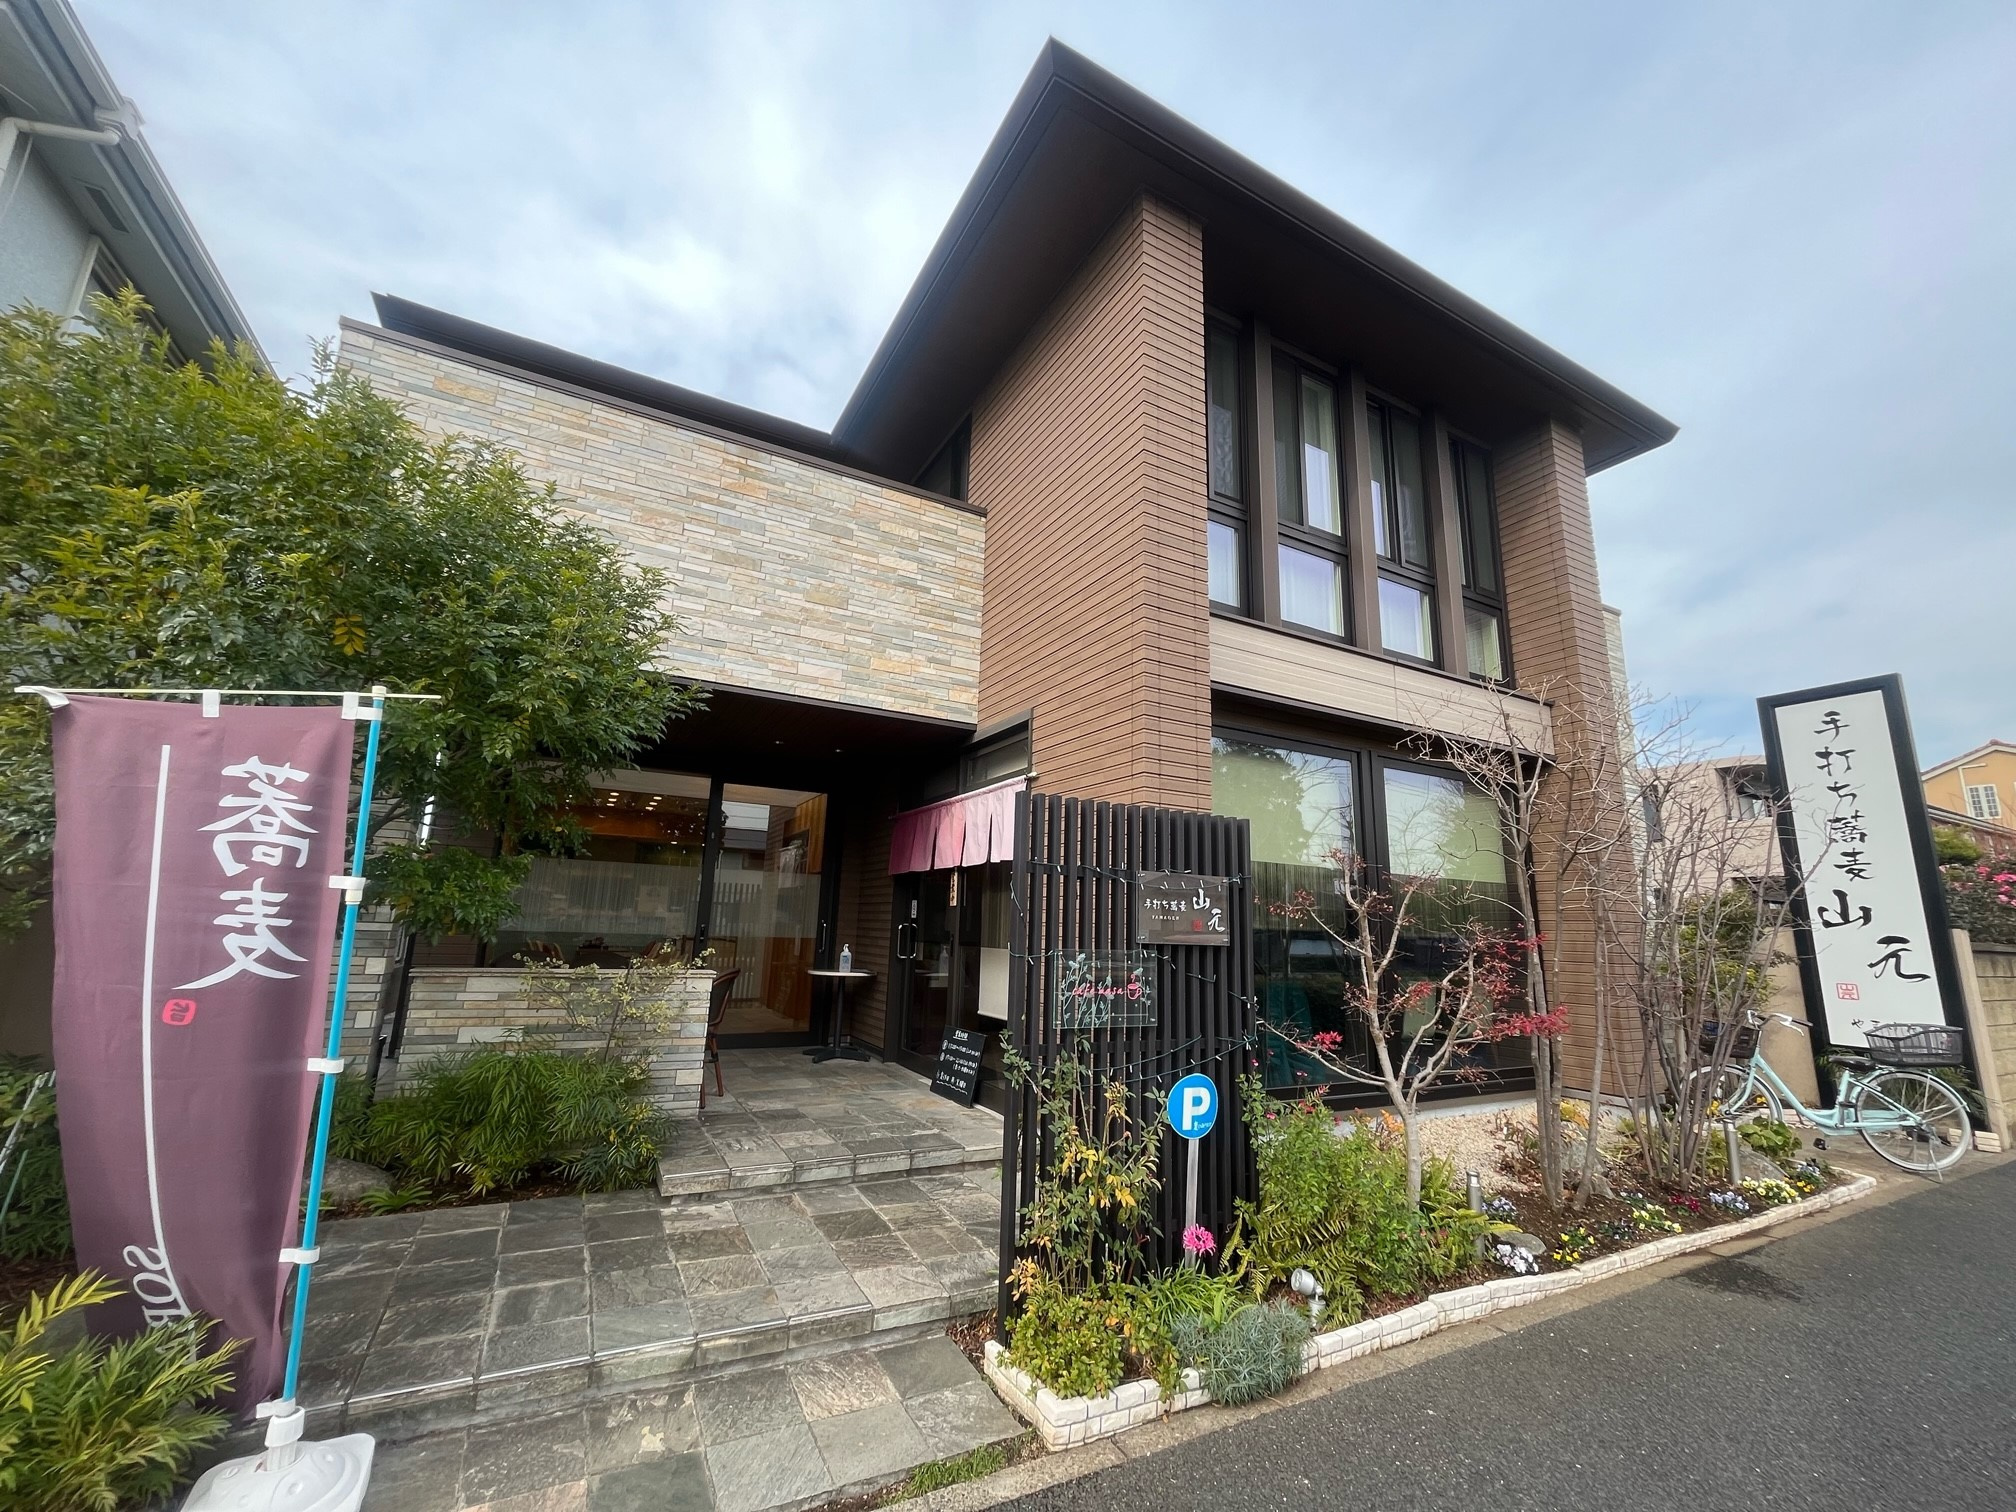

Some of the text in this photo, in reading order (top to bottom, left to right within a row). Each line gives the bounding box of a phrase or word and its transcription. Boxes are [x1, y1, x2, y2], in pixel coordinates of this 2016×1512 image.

[1814, 711, 1875, 882] 手打ち蕎麦
[1144, 898, 1187, 912] 手打ち蕎麦
[1192, 888, 1226, 933] 山元
[1818, 889, 1931, 983] 山元
[1182, 1086, 1210, 1131] P
